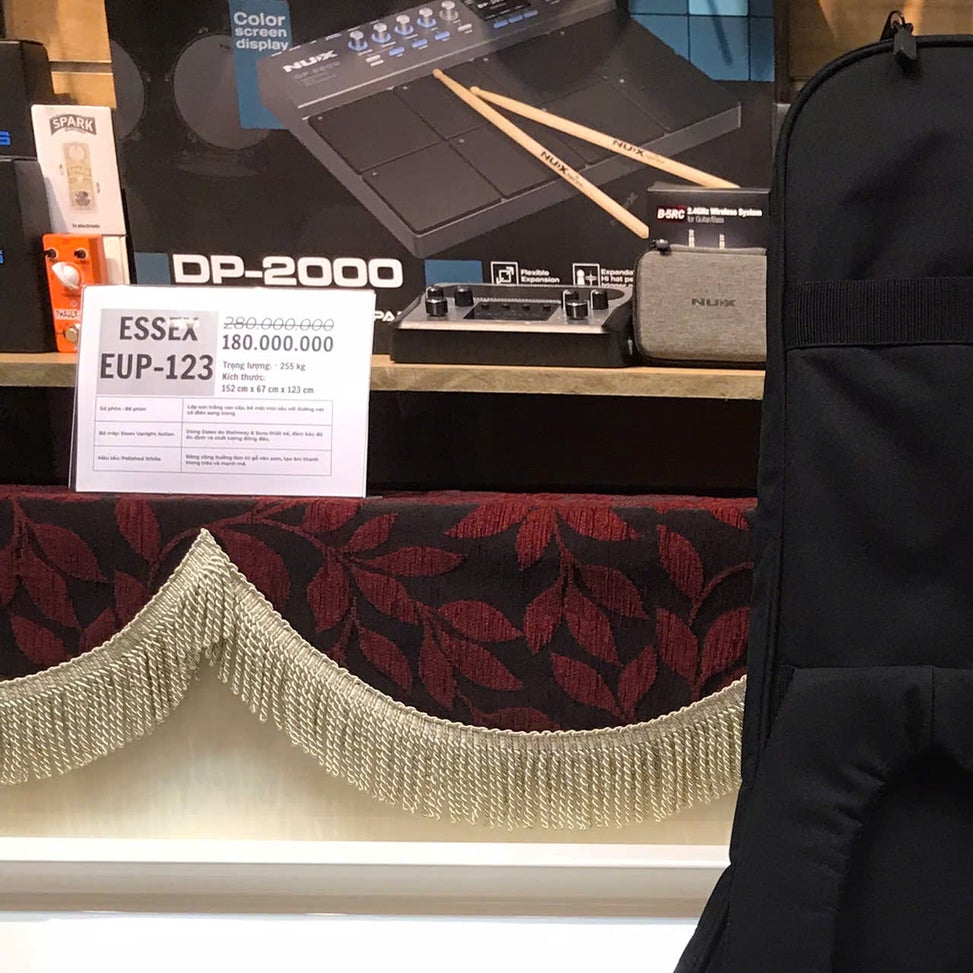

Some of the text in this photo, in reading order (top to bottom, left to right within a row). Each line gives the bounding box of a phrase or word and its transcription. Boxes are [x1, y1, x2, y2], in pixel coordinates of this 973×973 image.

[233, 11, 286, 26] Color
[235, 26, 287, 38] screen
[236, 38, 289, 51] display
[51, 115, 94, 133] SPARK
[710, 207, 737, 216] Wireless
[738, 208, 763, 218] System
[172, 253, 404, 289] DP-2000
[520, 268, 550, 277] Flexible
[601, 268, 634, 277] Expanda
[520, 276, 561, 285] Expansion
[119, 316, 199, 341] ESSEX
[223, 316, 335, 332] 280.000.000
[222, 334, 334, 352] 180.000.000
[99, 353, 214, 381] EUP-123
[280, 362, 295, 370] 255
[296, 363, 307, 372] kg
[222, 373, 239, 381] Kích
[221, 384, 236, 393] 152
[256, 385, 266, 393] 67
[287, 386, 301, 394] 123
